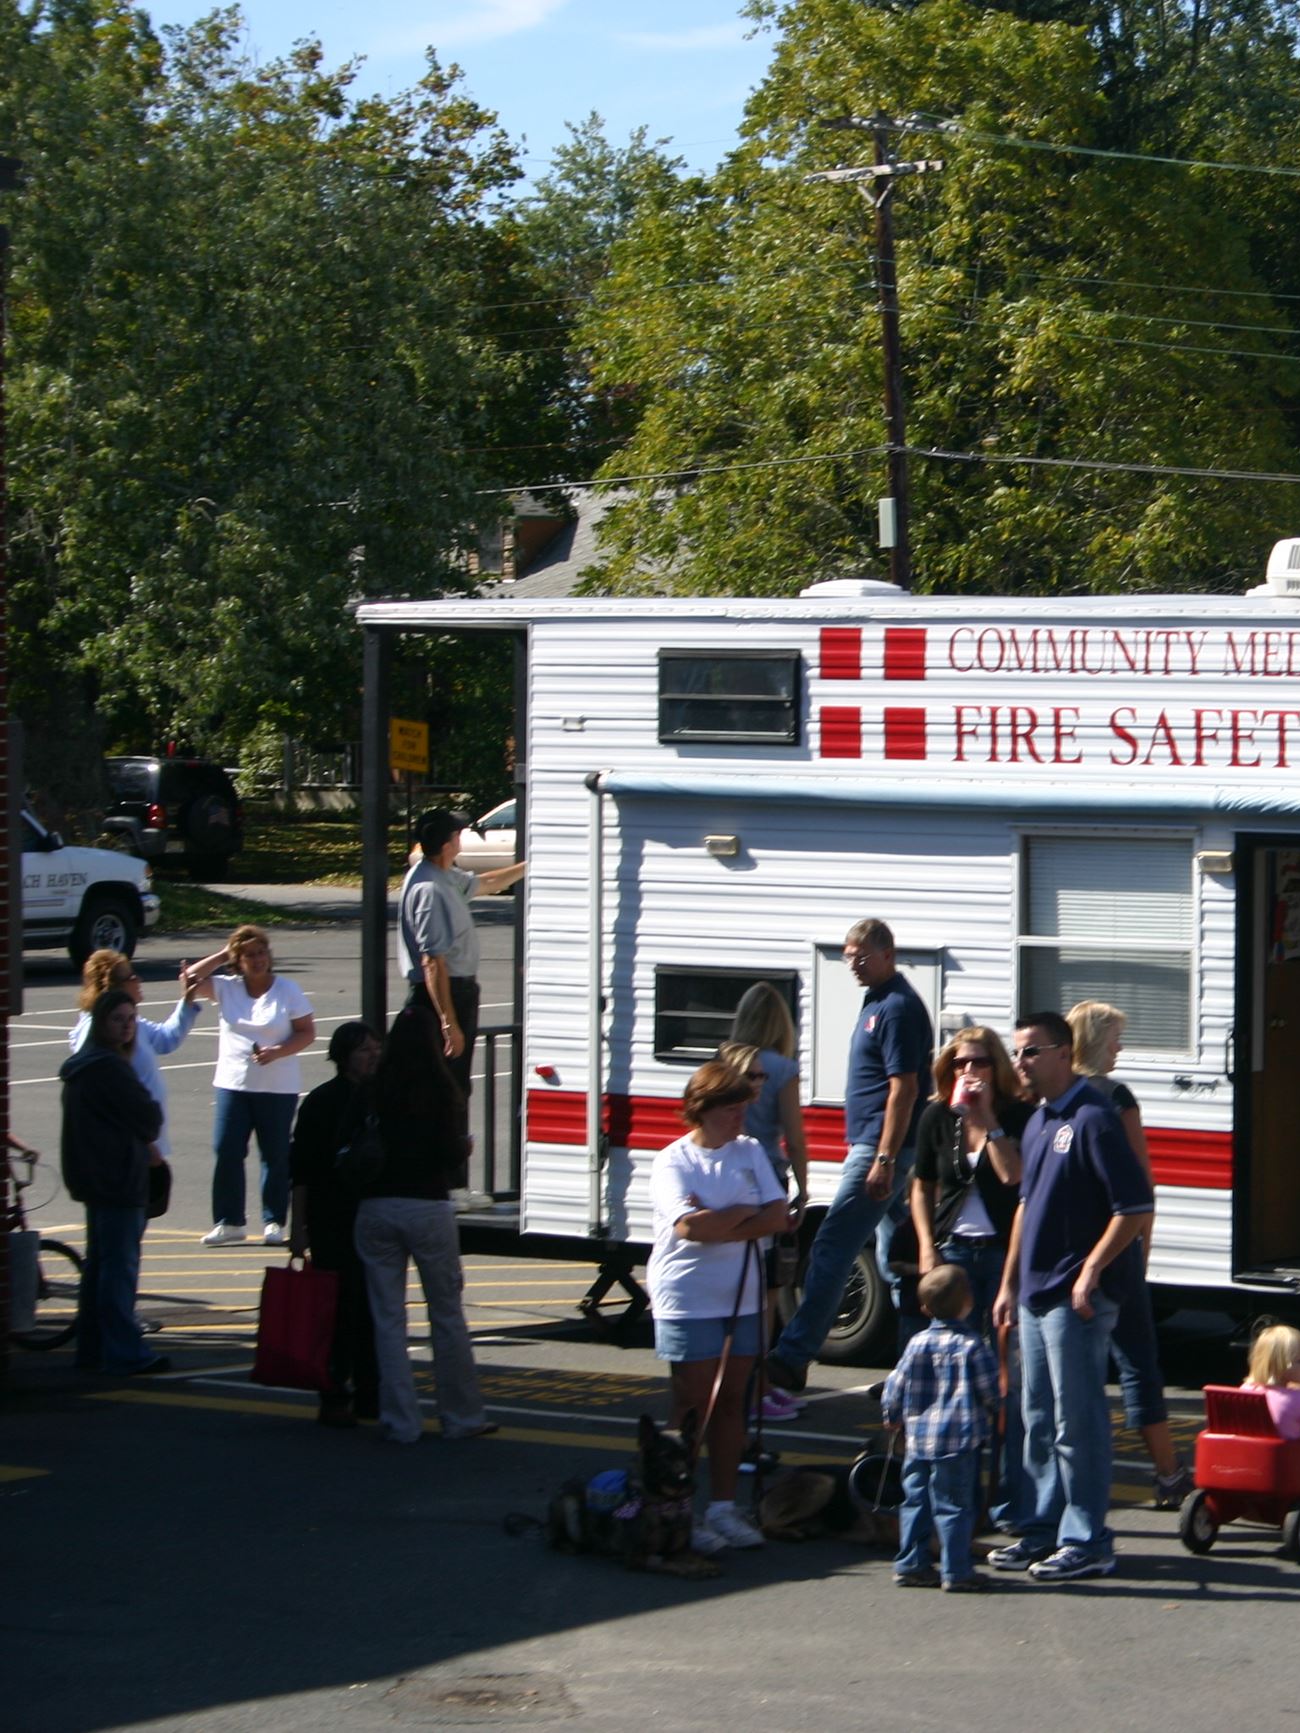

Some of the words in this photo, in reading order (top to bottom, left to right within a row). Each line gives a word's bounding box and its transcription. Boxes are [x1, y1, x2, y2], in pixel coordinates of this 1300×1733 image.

[948, 627, 1209, 675] COMMUNITY
[951, 704, 1083, 764] FIRE
[47, 872, 89, 887] HAVEN
